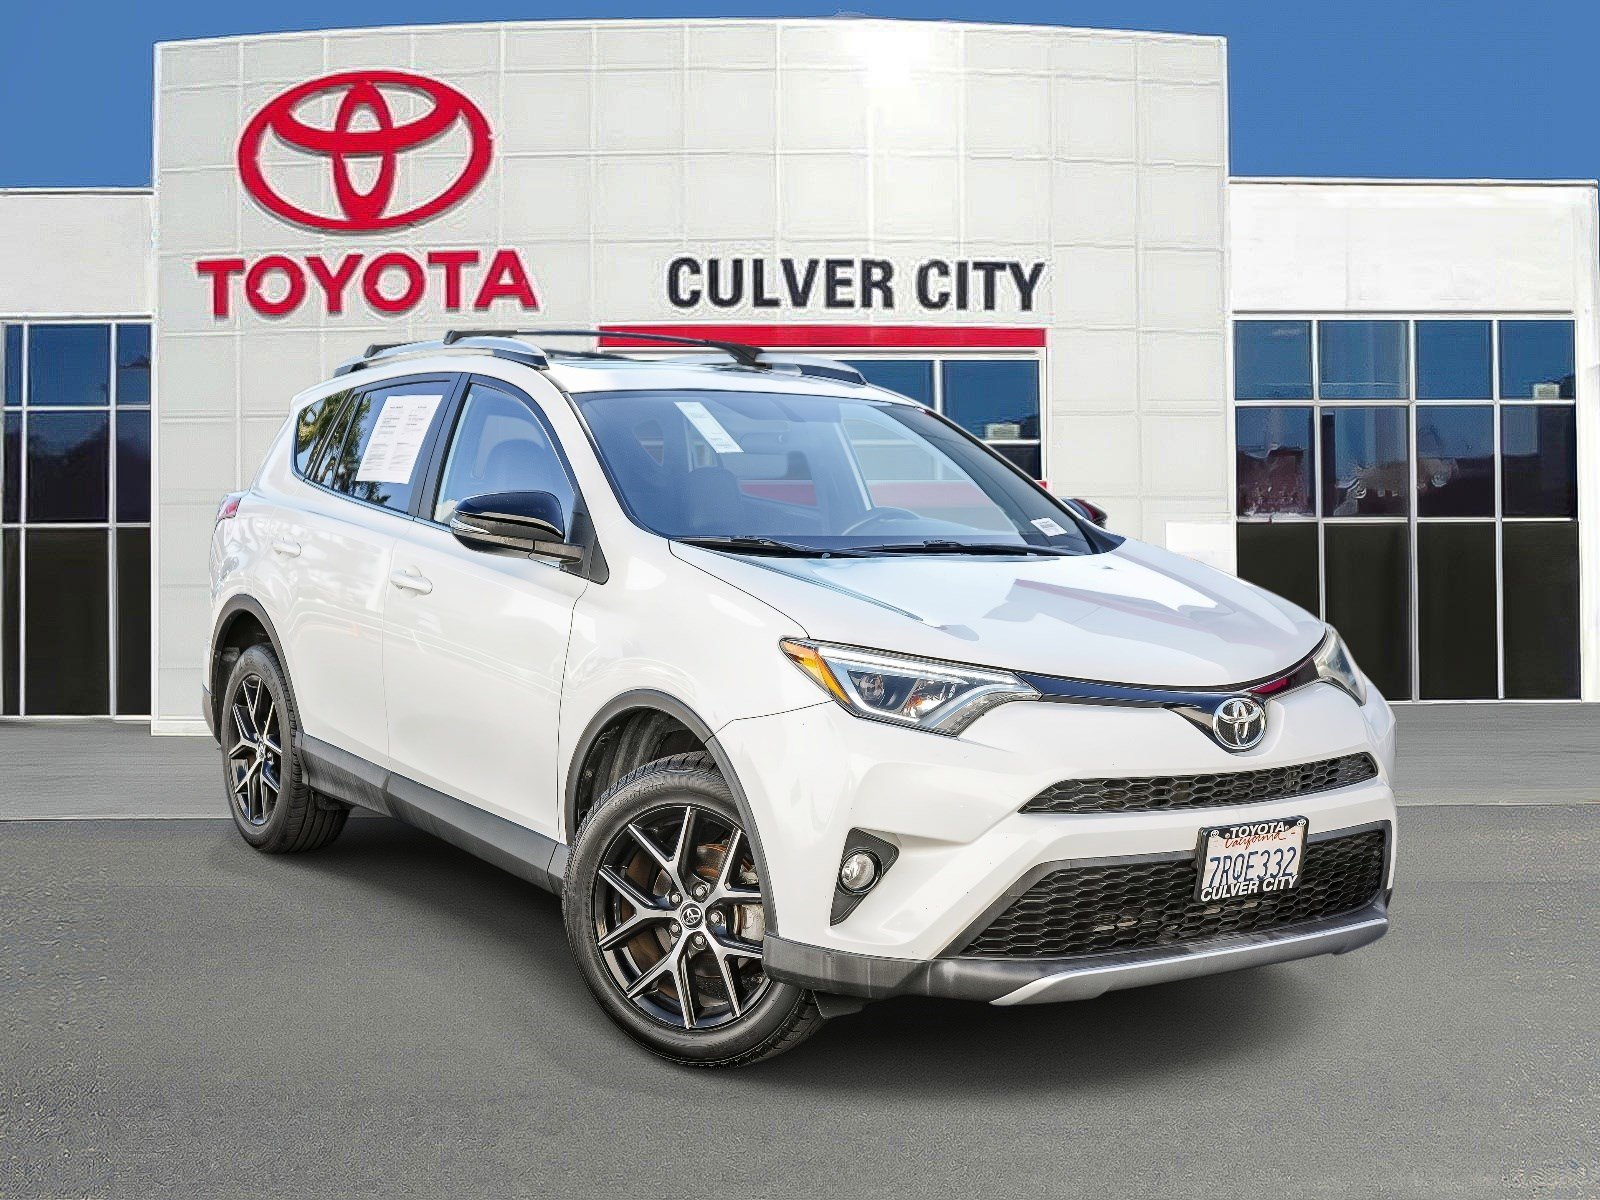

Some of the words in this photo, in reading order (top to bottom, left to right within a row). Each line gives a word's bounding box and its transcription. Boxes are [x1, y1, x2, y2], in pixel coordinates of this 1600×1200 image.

[196, 250, 538, 318] TOYOTA
[667, 257, 895, 309] CULVER
[915, 259, 1045, 311] CITY
[1229, 821, 1285, 839] TOYOTA
[1200, 880, 1259, 902] CULVER
[1262, 874, 1298, 892] CITY
[1209, 846, 1297, 888] 7RQE332
